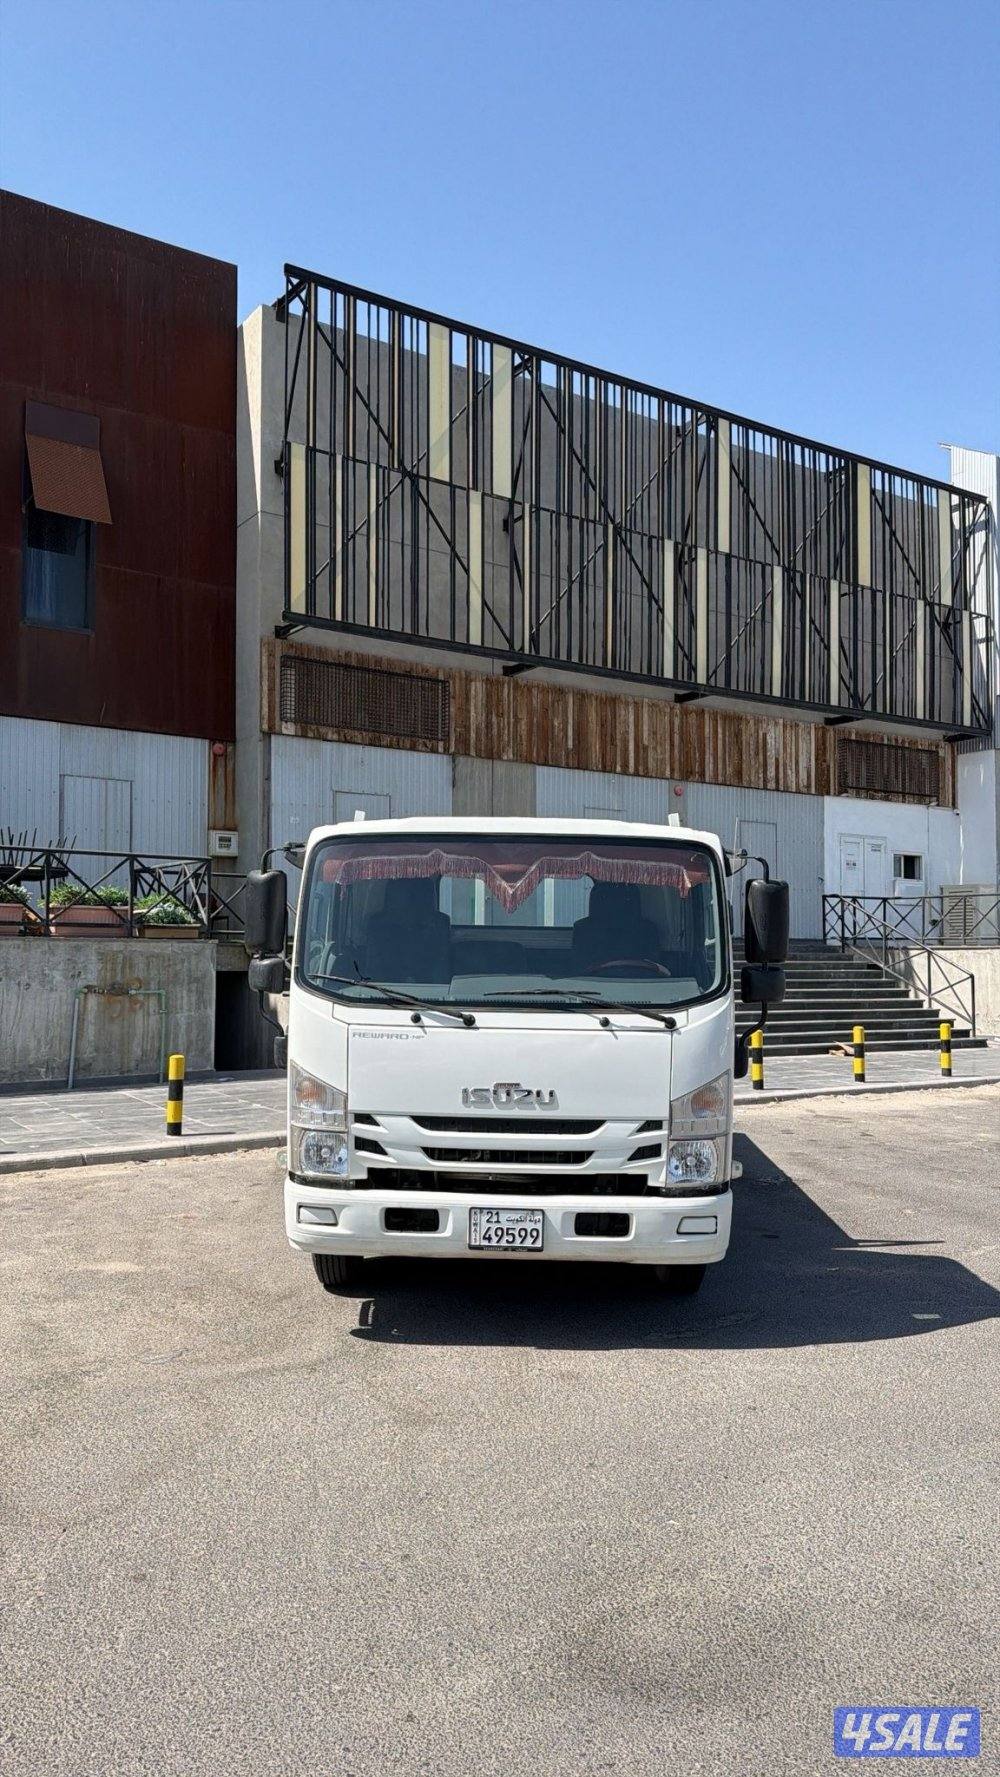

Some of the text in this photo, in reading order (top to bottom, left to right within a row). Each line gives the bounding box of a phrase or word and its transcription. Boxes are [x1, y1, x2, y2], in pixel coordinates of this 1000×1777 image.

[352, 1031, 410, 1040] REWARD
[461, 1086, 559, 1110] ISUZU
[486, 1211, 501, 1224] 21
[505, 1214, 527, 1224] الكويت
[482, 1226, 540, 1245] 49599
